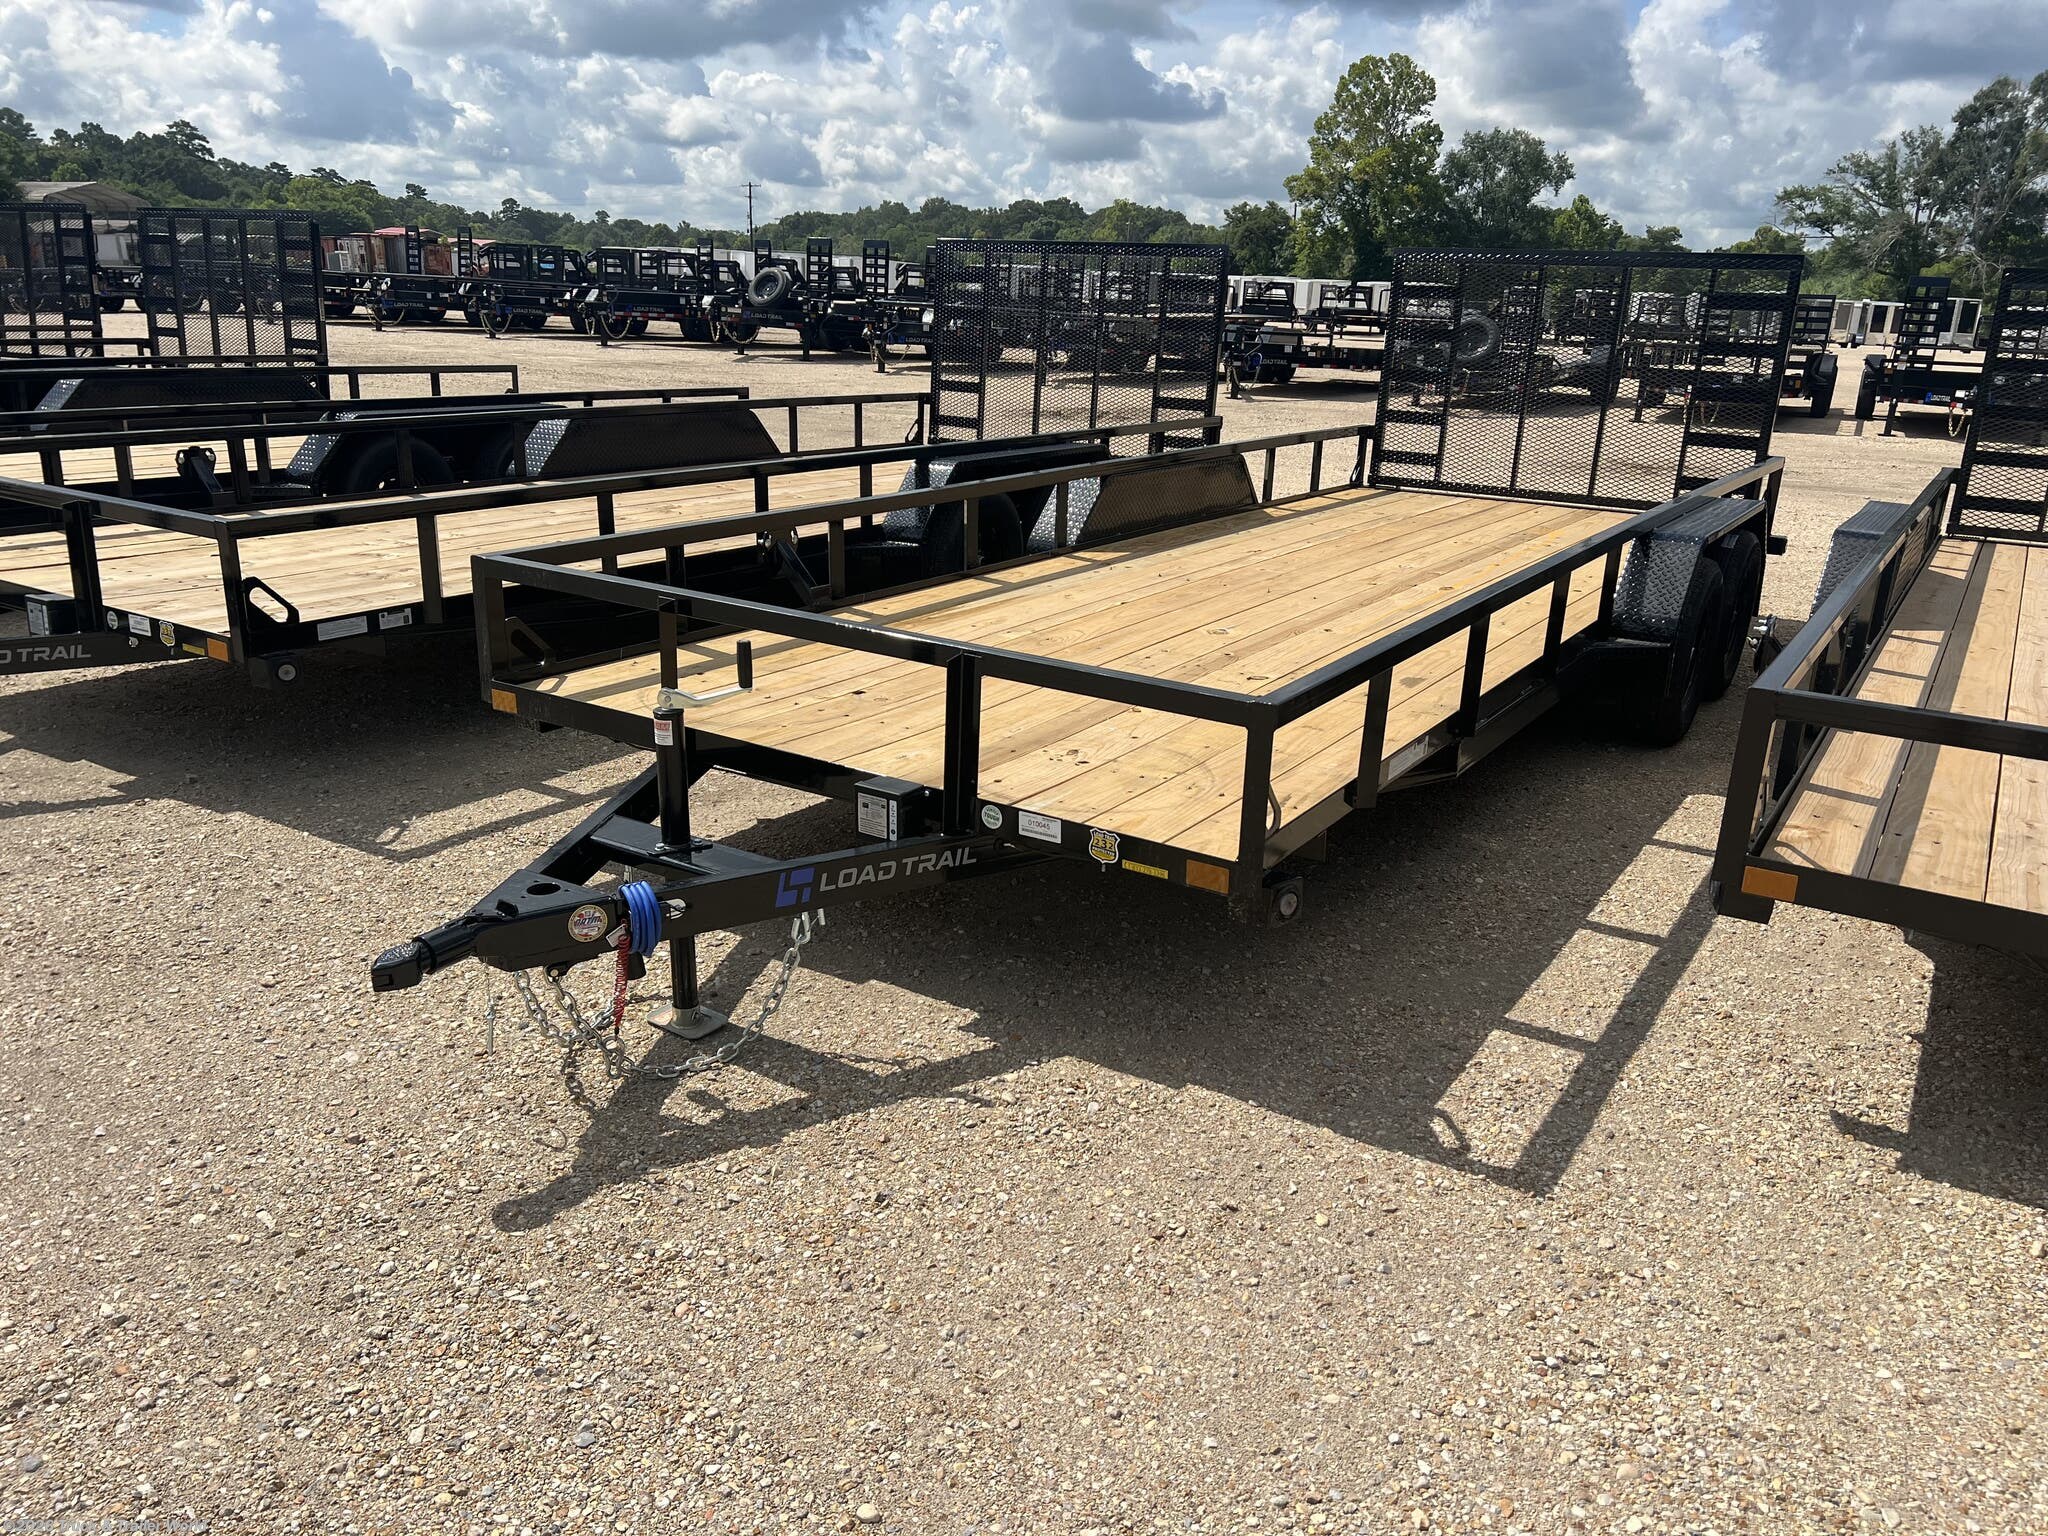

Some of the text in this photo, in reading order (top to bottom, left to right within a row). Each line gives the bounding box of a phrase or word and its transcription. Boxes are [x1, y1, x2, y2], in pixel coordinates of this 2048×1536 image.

[16, 644, 92, 663] TRAIL
[1094, 838, 1114, 850] 232
[819, 847, 977, 892] LOAD TRAIL
